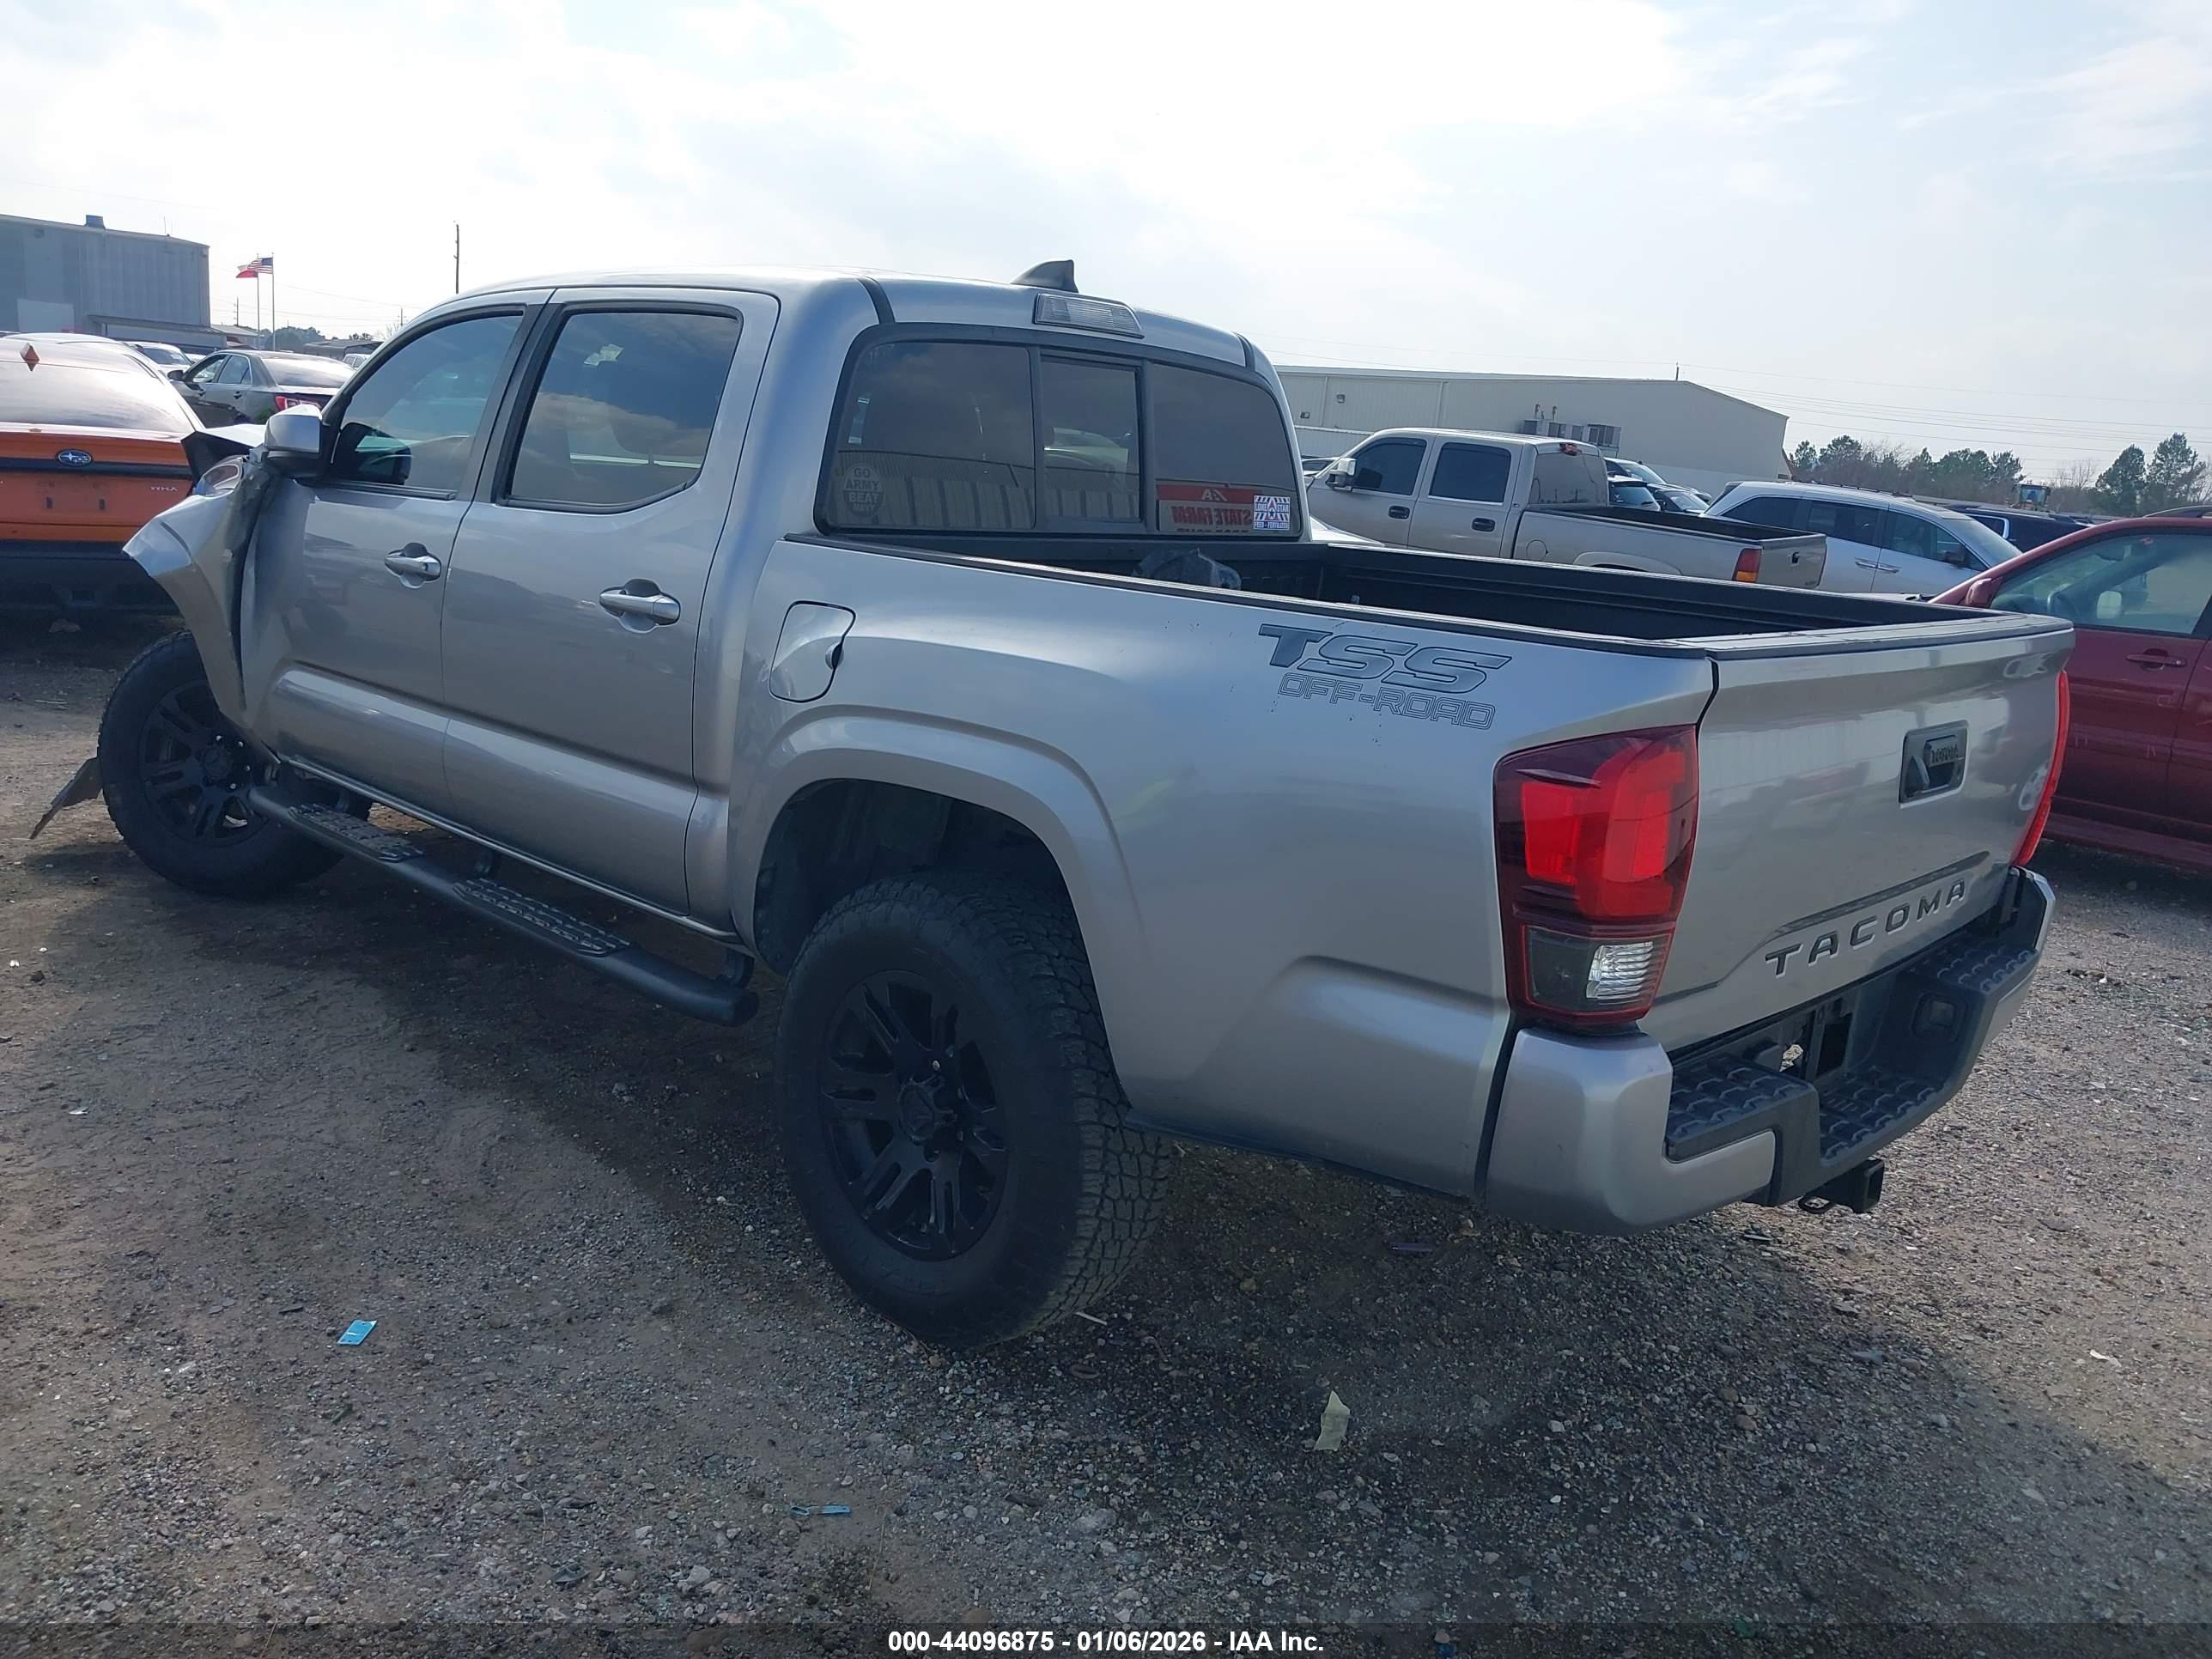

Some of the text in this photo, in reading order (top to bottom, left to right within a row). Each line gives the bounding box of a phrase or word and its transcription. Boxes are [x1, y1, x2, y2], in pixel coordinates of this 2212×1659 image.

[854, 467, 872, 477] GO
[846, 479, 880, 490] ARMY
[848, 492, 879, 502] BEAT
[1255, 503, 1289, 513] LONE STAR
[1259, 623, 1512, 694] TSS
[1278, 672, 1496, 730] OFF-ROAD
[1765, 878, 1966, 978] TACOMA
